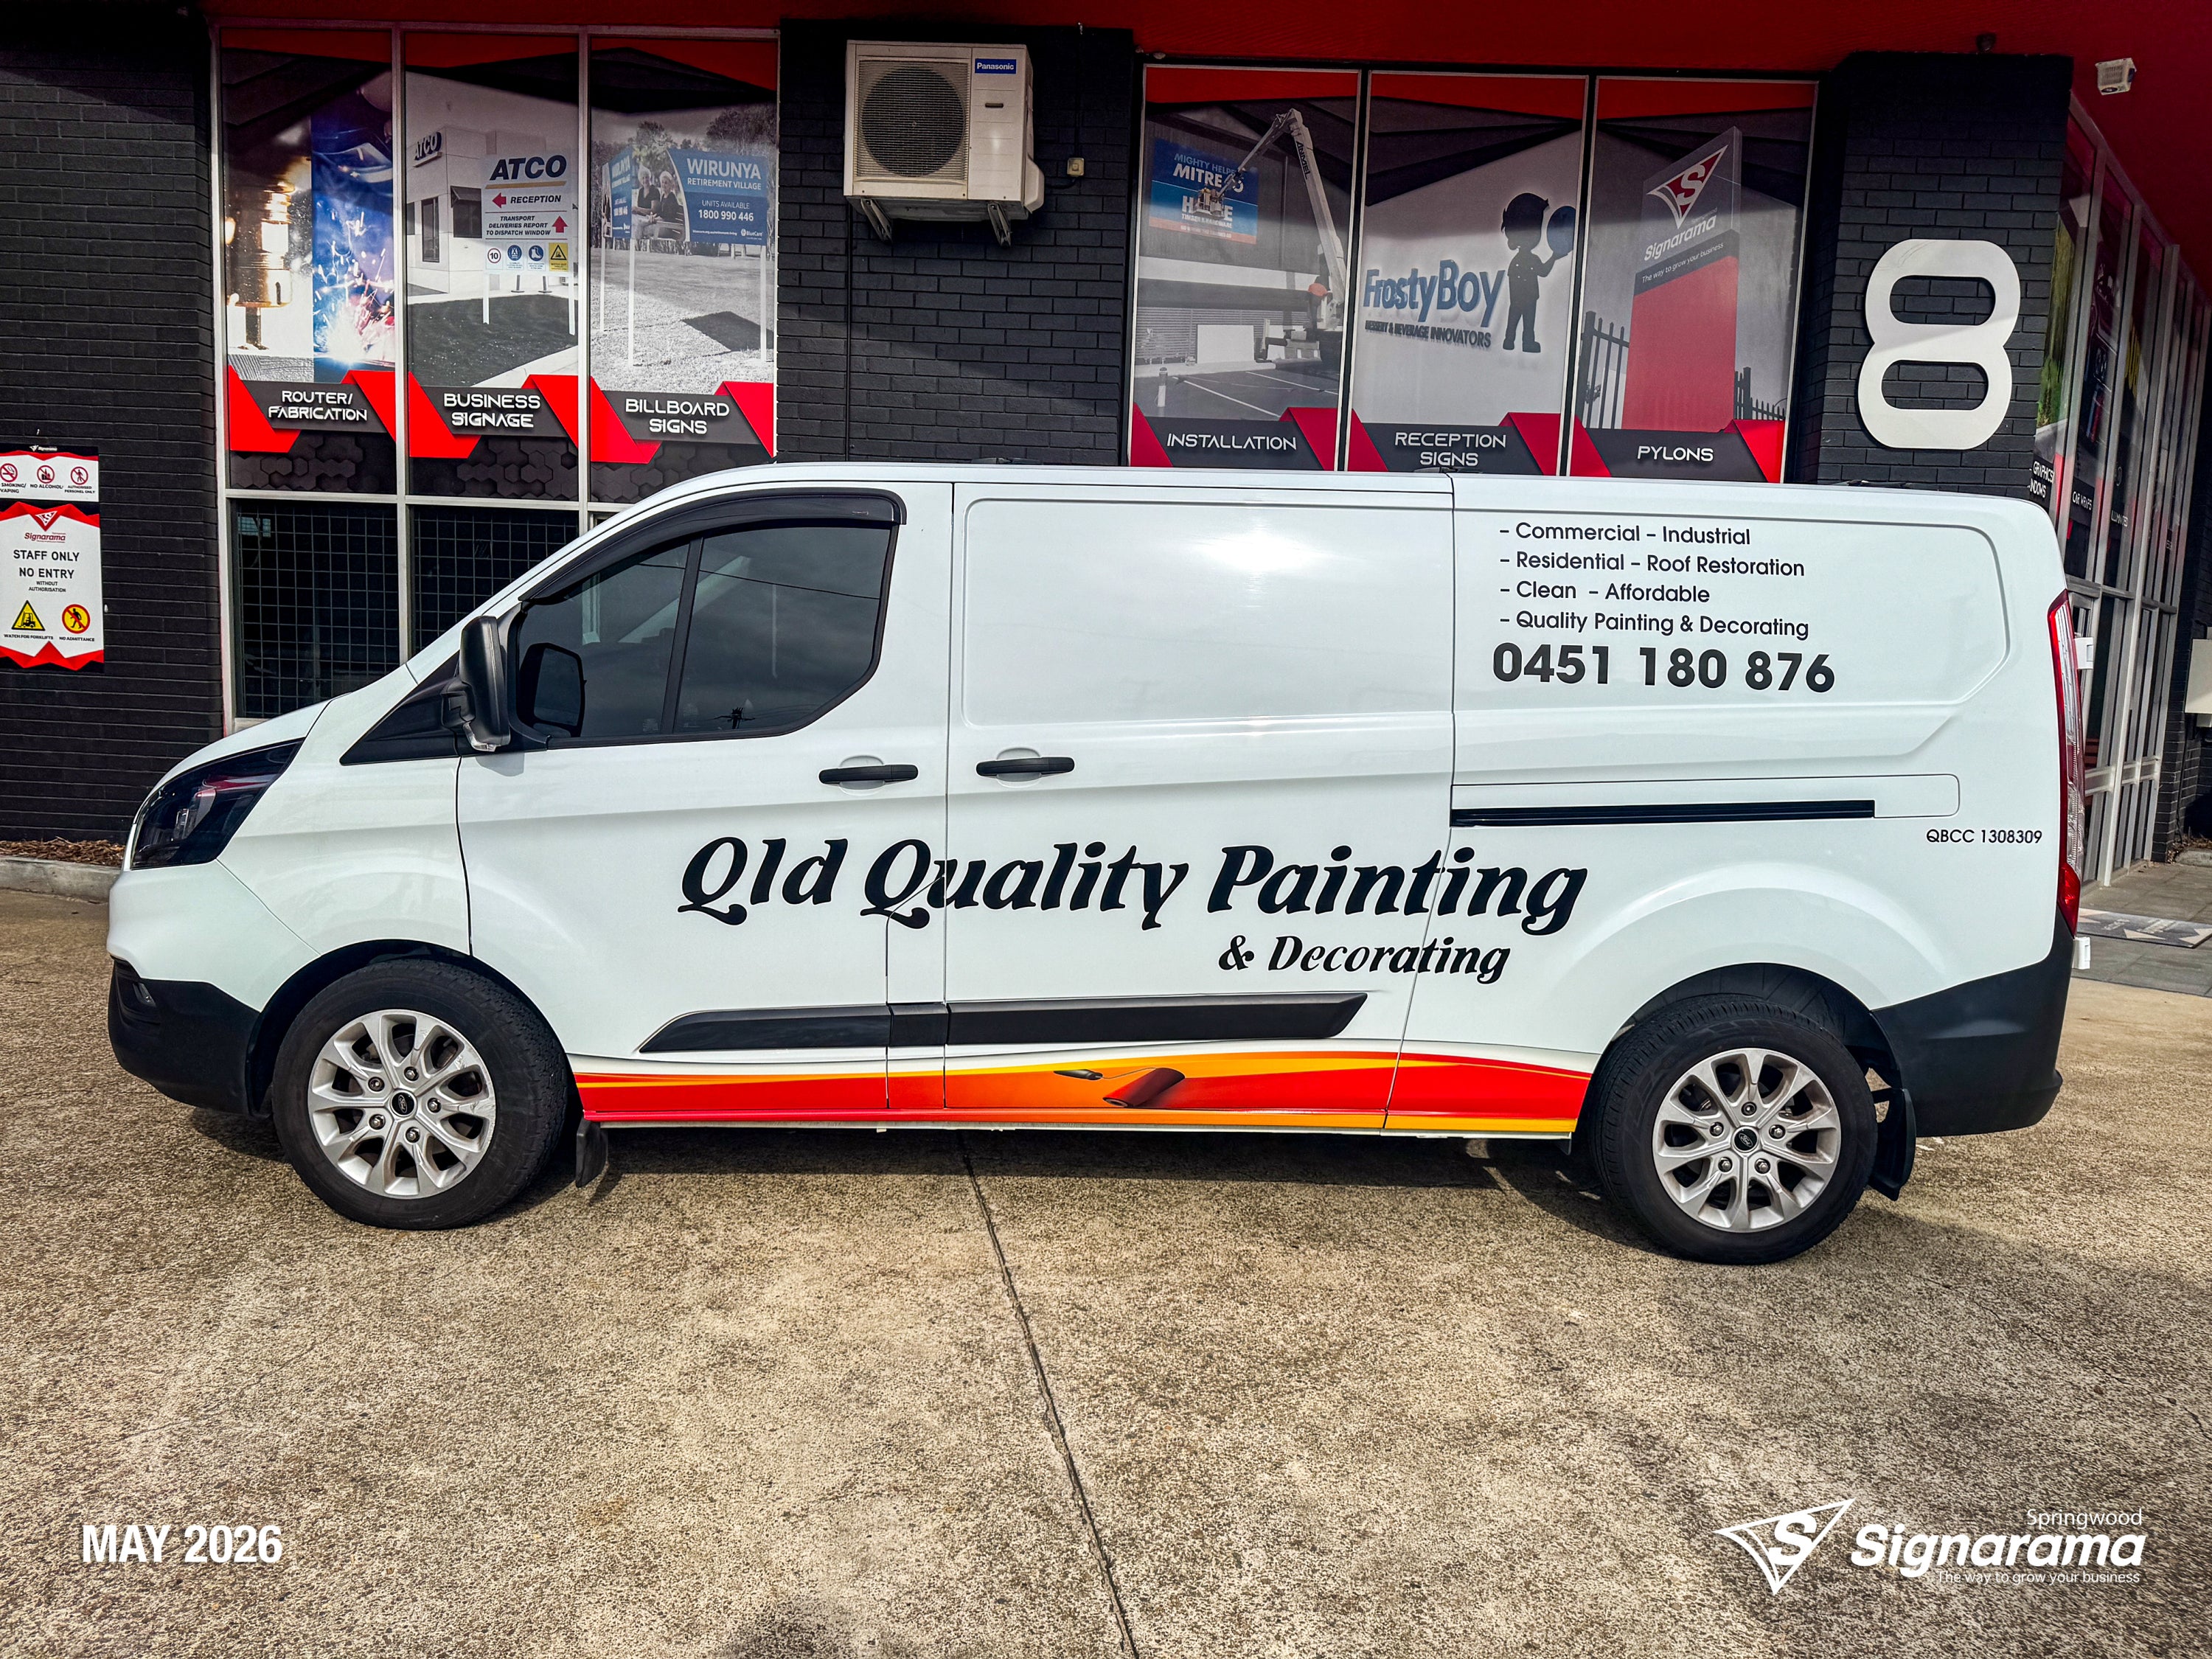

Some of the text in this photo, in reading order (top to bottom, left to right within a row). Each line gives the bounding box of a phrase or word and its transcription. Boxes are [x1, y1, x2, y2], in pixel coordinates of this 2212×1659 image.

[977, 62, 1014, 70] Panasonic
[490, 154, 567, 181] ATCO
[686, 158, 762, 180] WIRUNYA
[1174, 153, 1210, 169] MIGHTY
[687, 178, 762, 190] RETIREMENT VILLAGE
[1173, 163, 1222, 188] MITRE
[510, 195, 561, 204] RECEPTION
[702, 200, 750, 209] UNITS AVAILABLE
[1182, 195, 1234, 222] HE
[698, 209, 754, 221] 1800 990 446
[1644, 215, 1717, 261] Signarama
[1642, 275, 1652, 284] The
[1652, 268, 1665, 279] way
[1672, 259, 1687, 271] grow
[1686, 254, 1700, 265] your
[1700, 243, 1724, 257] business
[1363, 260, 1506, 327] FrostyBoy
[1394, 323, 1430, 338] BEVERAGE
[1430, 327, 1492, 348] INNOVATORS
[1858, 239, 2021, 450] 8
[282, 390, 352, 405] ROUTER/
[444, 392, 540, 409] BUSINESS
[268, 405, 367, 422] FABRICATION
[625, 398, 730, 417] BILLBOARD
[451, 411, 535, 428] SIGNAGE
[649, 418, 708, 434] SIGNS
[1167, 433, 1297, 451] INSTALLATION
[1395, 432, 1506, 448] RECEPTION
[1420, 451, 1478, 466] SIGNS
[1638, 445, 1714, 462] PYLONS
[2072, 491, 2092, 510] CAR WRAPS
[24, 532, 66, 541] Signarama
[1516, 522, 1640, 541] Commercial
[1663, 526, 1750, 545] Industrial
[13, 549, 80, 562] STAFF ONLY
[1517, 551, 1624, 570] Residential
[1648, 554, 1691, 572] Roof
[1697, 557, 1805, 577] Restoration
[19, 567, 74, 579] NO ENTRY
[1517, 580, 1576, 599] Clean
[1605, 582, 1710, 602] Affordable
[1517, 610, 1587, 633] Quality
[1595, 613, 1674, 636] Painting
[1680, 614, 1694, 633] &
[1700, 616, 1809, 641] Decorating
[1493, 642, 1835, 693] 0451 180 876
[1926, 829, 2042, 844] QBCC 1308309
[678, 836, 1587, 936] Qld Quality Painting
[1219, 935, 1511, 984] & Decorating
